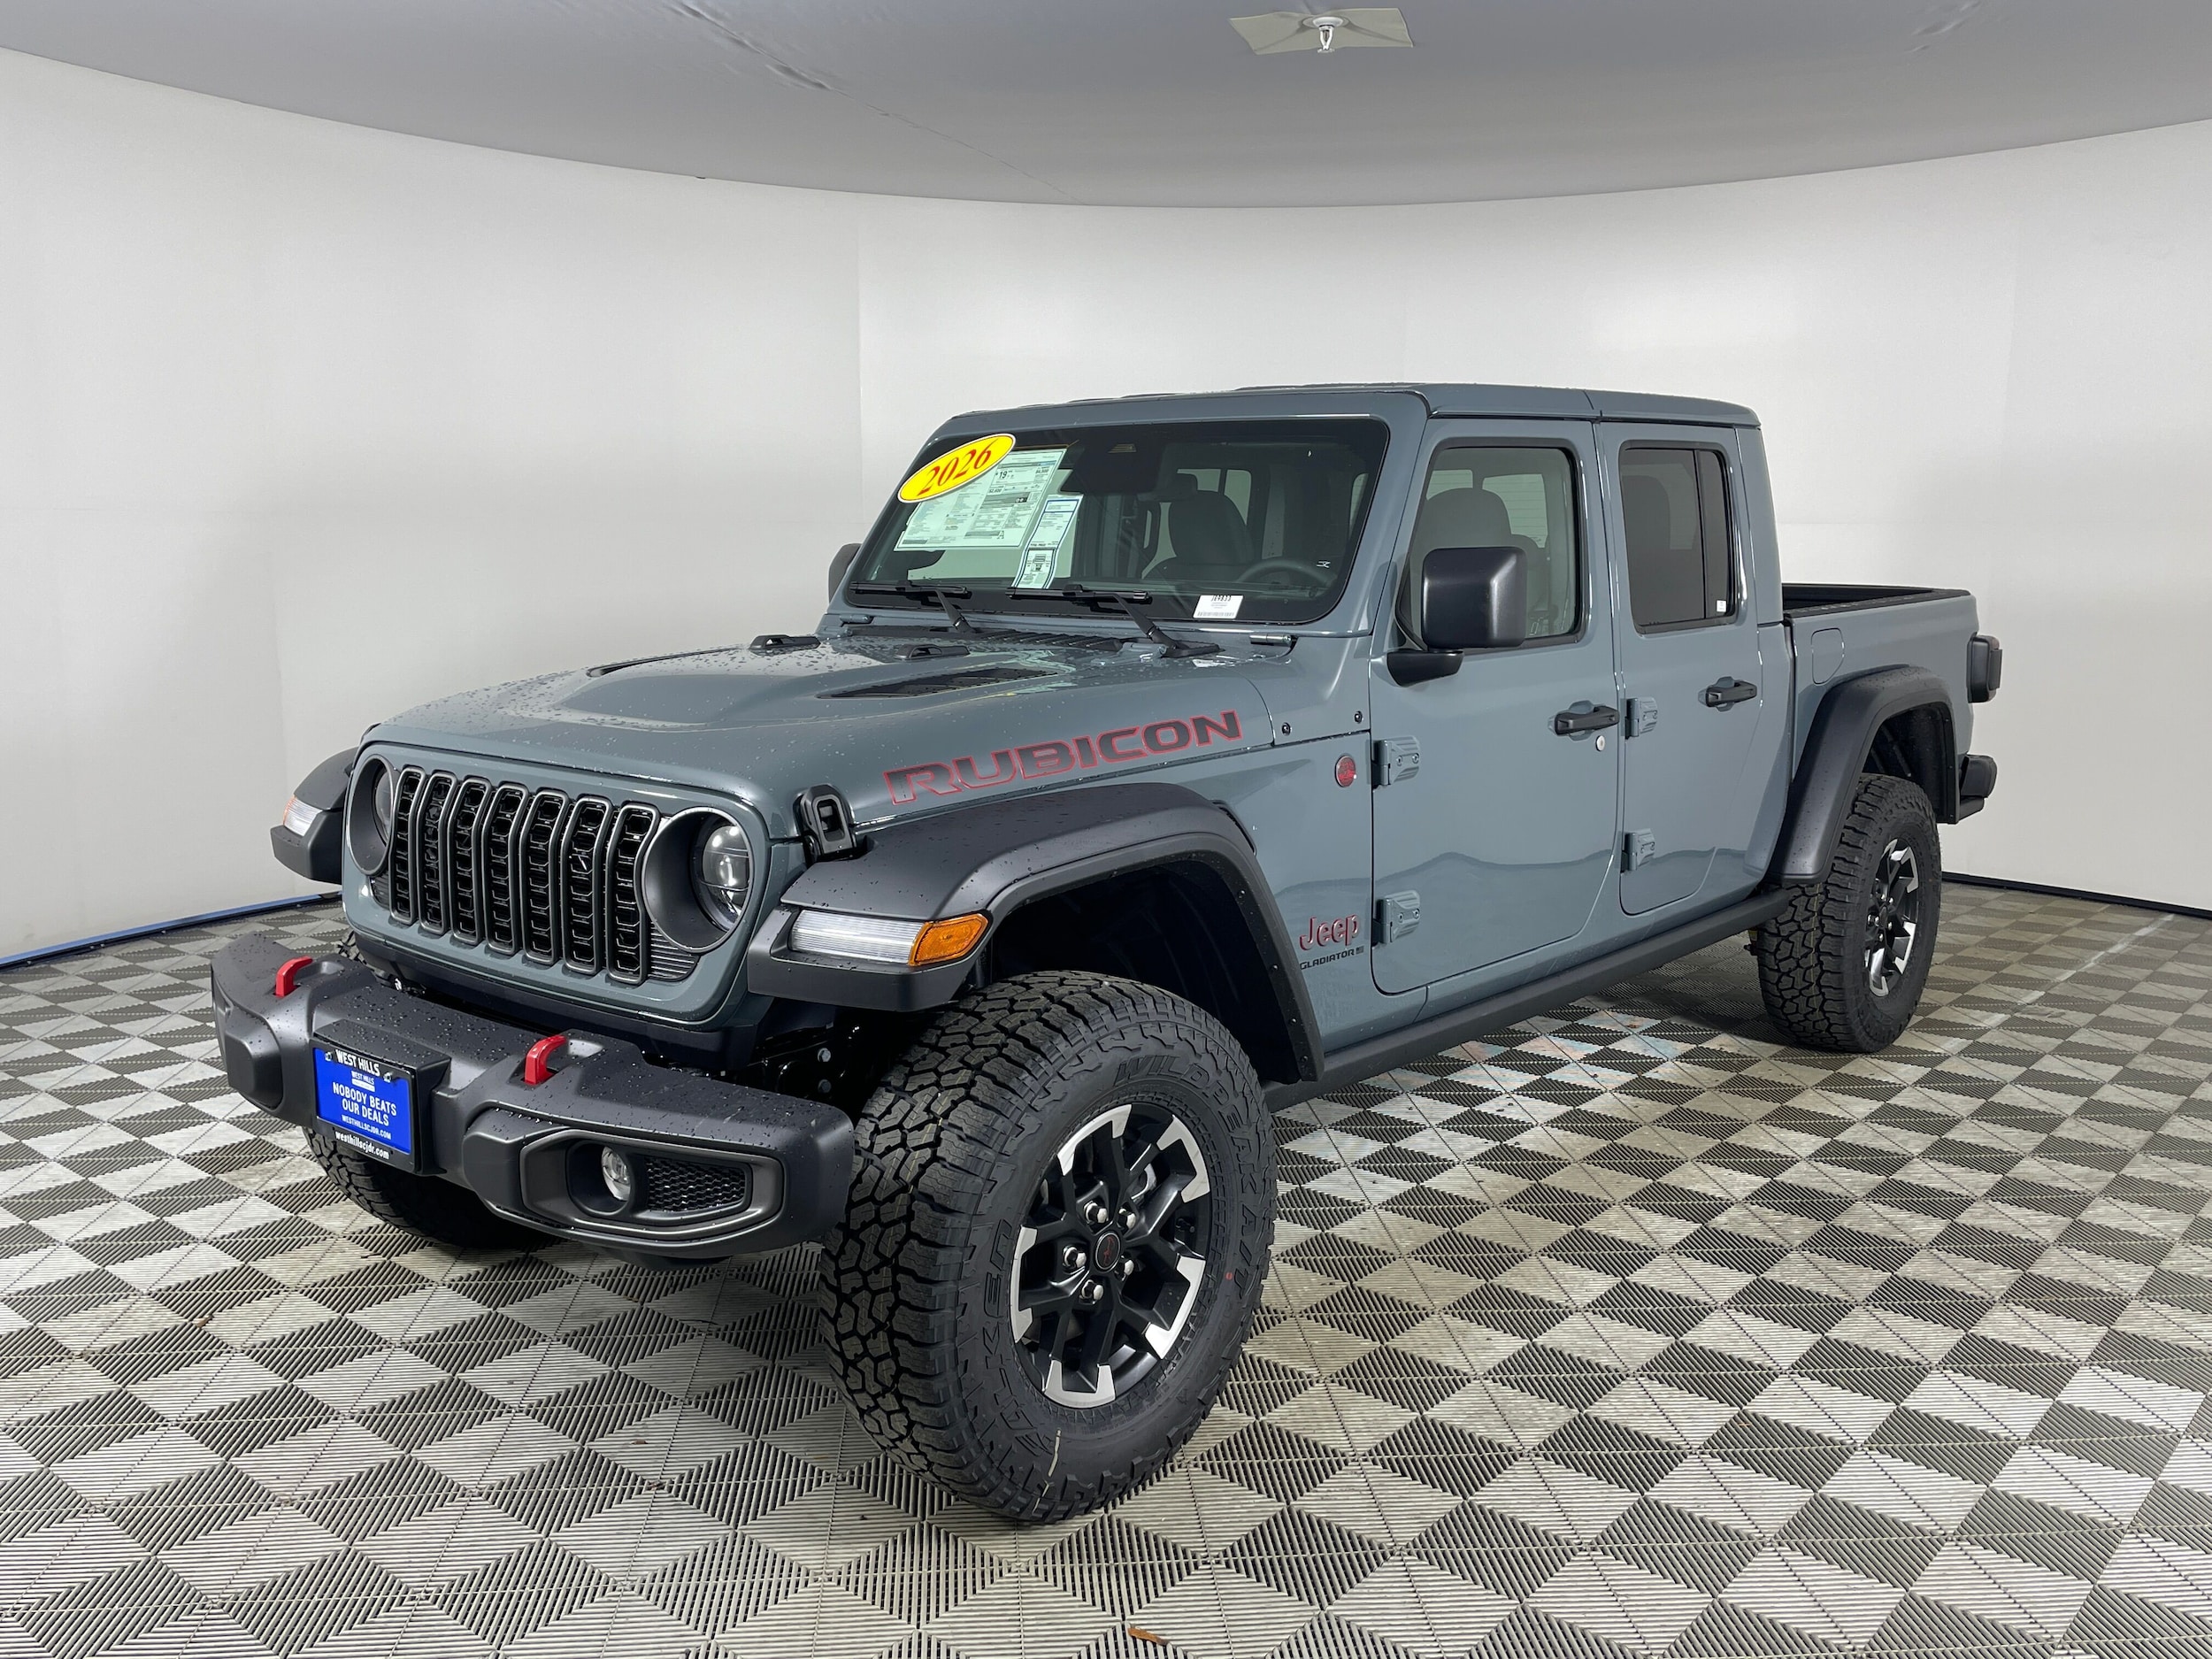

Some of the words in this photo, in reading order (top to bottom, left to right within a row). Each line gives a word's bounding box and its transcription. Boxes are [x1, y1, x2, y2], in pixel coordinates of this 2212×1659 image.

[917, 439, 998, 496] 2026
[883, 710, 1243, 805] RUBICON
[1299, 914, 1359, 950] Jeep
[1299, 949, 1355, 970] GLADIATOR
[335, 1049, 357, 1068] WEST
[358, 1057, 380, 1077] HILLS
[351, 1071, 363, 1080] WEST
[363, 1075, 375, 1086] HILLS
[333, 1082, 367, 1102] NOBODY
[369, 1095, 396, 1117] BEATS
[342, 1098, 360, 1116] OUR
[361, 1105, 389, 1126] DEALS
[342, 1114, 392, 1141] WESTHILLSCJDR.COM
[334, 1130, 389, 1160] westhillscjdr.com
